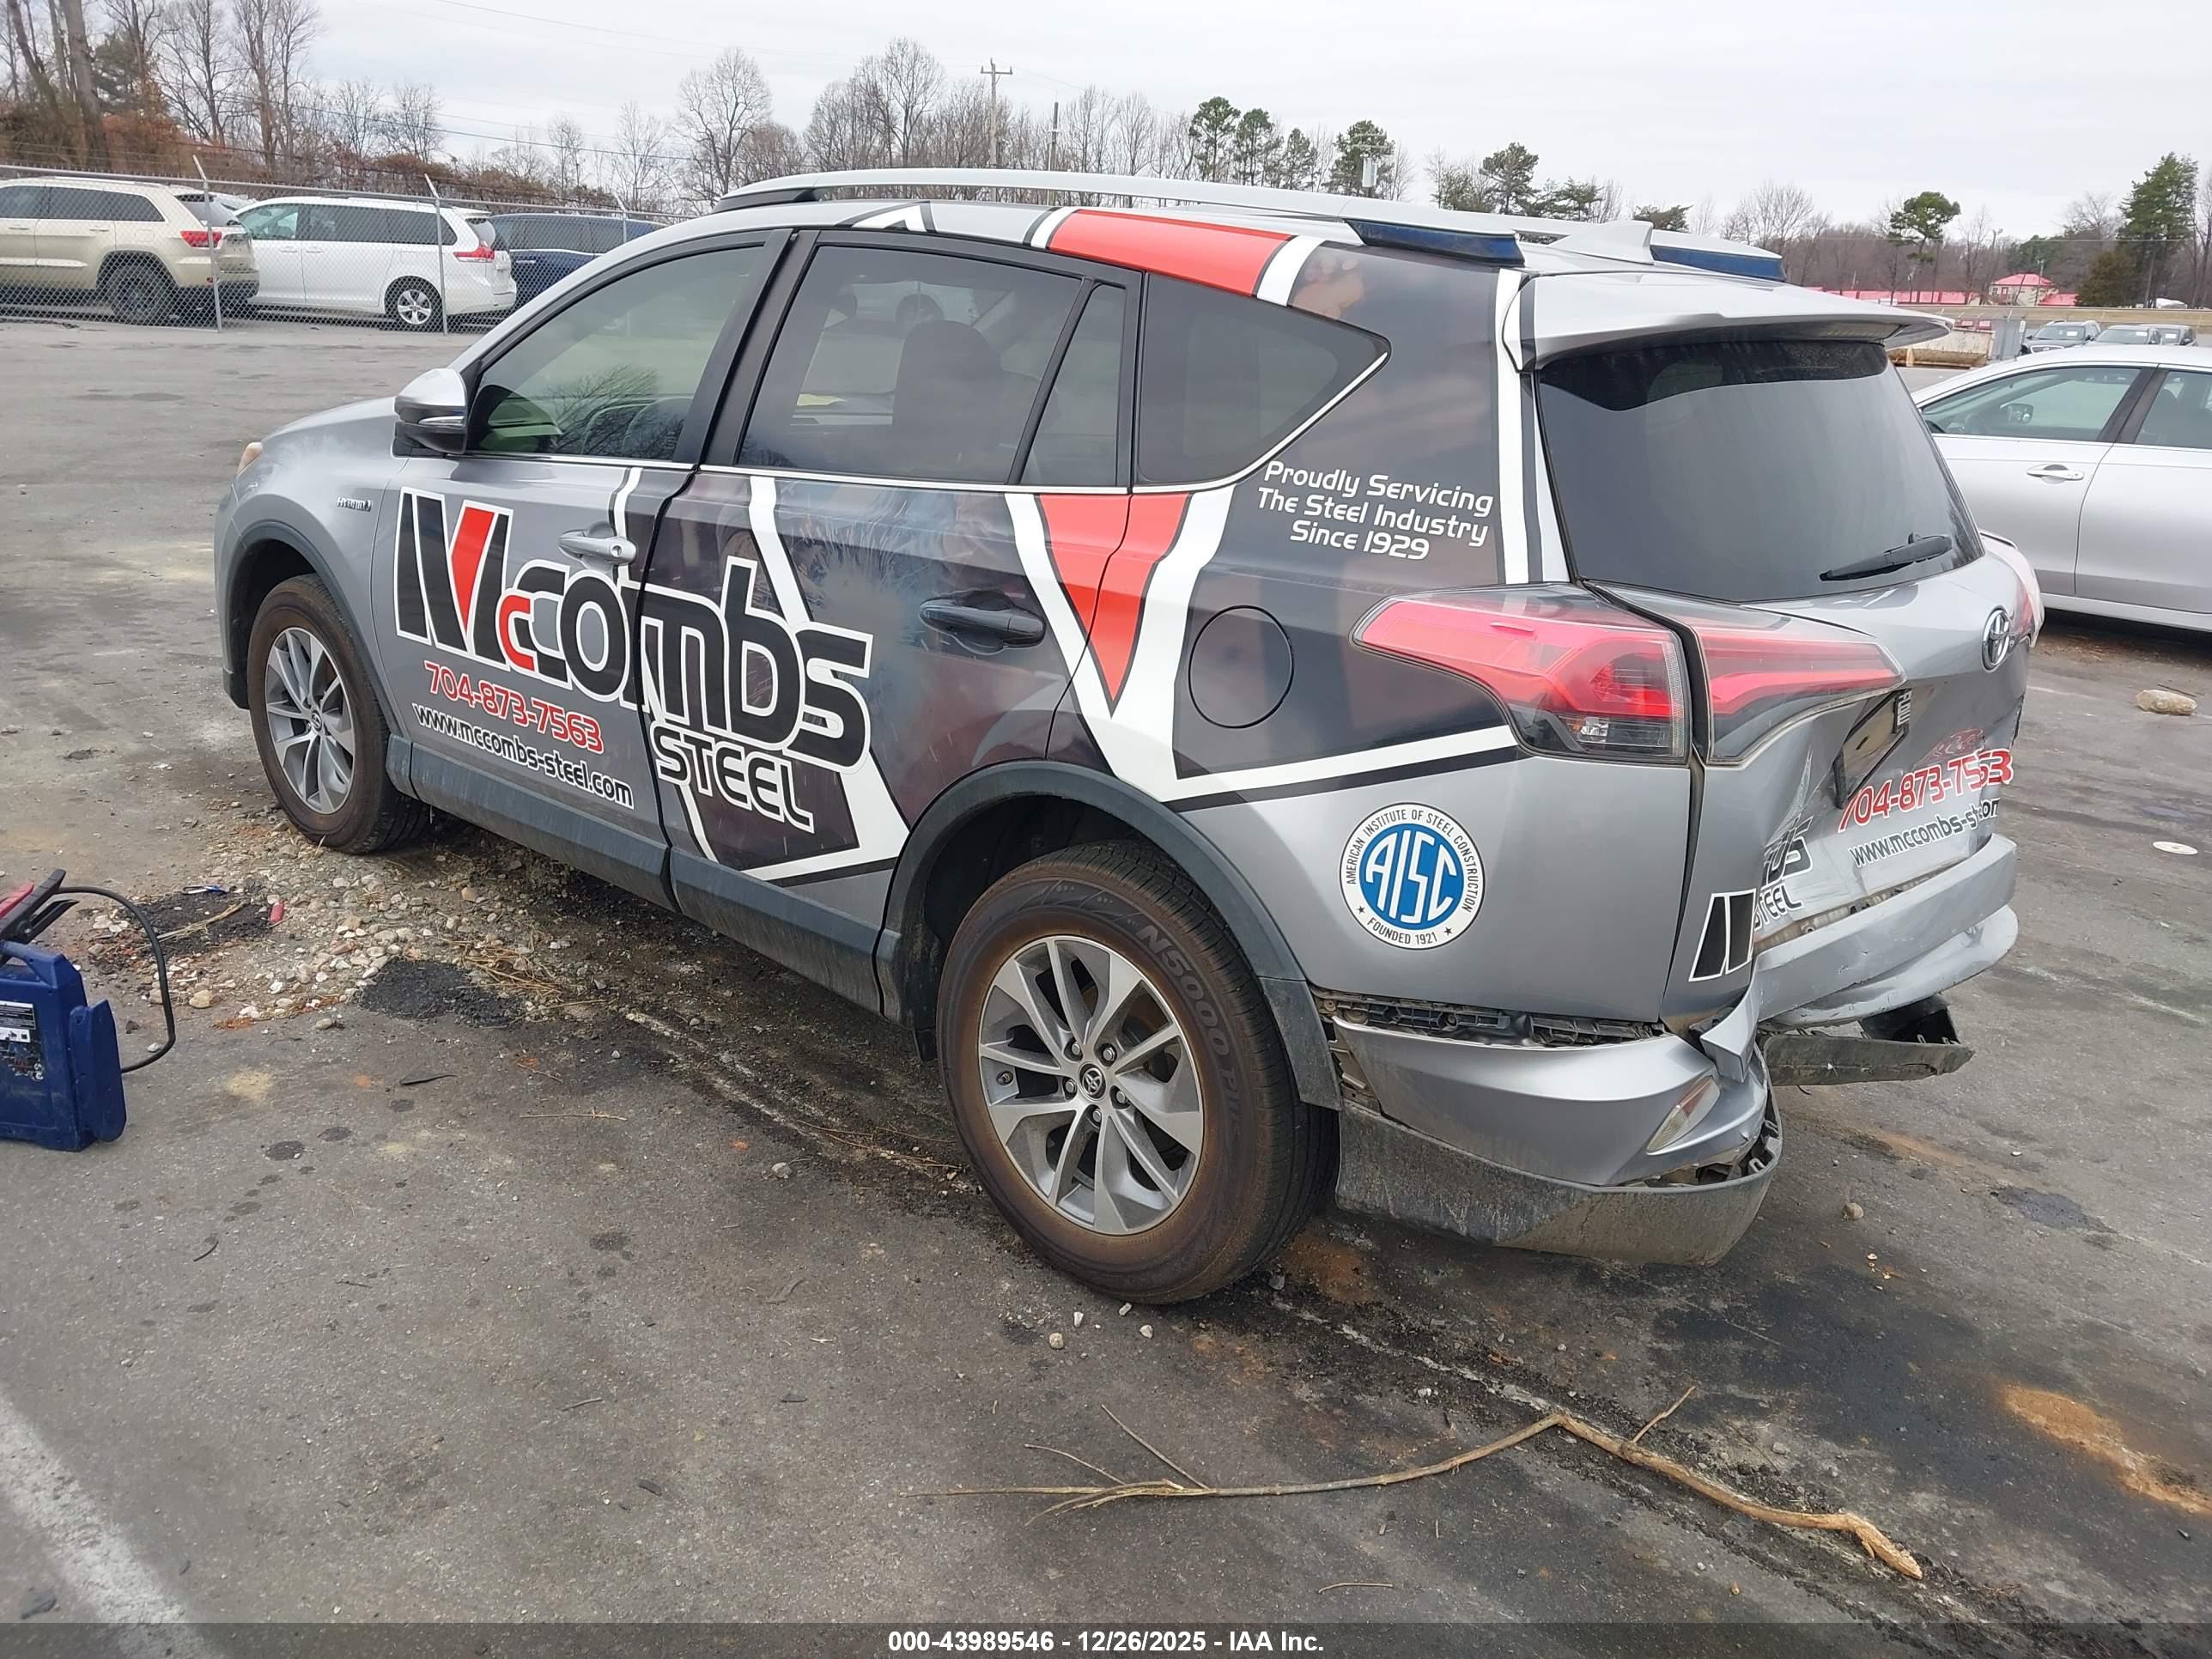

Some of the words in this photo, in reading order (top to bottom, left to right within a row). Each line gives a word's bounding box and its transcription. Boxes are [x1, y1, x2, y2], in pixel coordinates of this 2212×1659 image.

[1257, 487, 1299, 513] The
[1304, 494, 1369, 524] Steel
[1374, 504, 1489, 547] Industry
[1264, 460, 1360, 498] Proudly
[1366, 474, 1494, 518] Servicing
[1290, 520, 1358, 550] Since
[1363, 531, 1430, 560] 1929
[424, 660, 604, 754] 704-873-7563
[412, 703, 634, 810] www.mccombs-steel.com
[648, 720, 815, 834] STEEL
[1346, 837, 1365, 884] AMERICAN
[1363, 809, 1407, 837] INSTITUTE
[1411, 809, 1425, 821] OF
[1425, 812, 1455, 837] STEEL
[1453, 836, 1479, 913] CONSTRUCTION
[1365, 830, 1457, 924] AISC
[1367, 917, 1411, 945] FOUNDED
[1415, 932, 1438, 945] 1921
